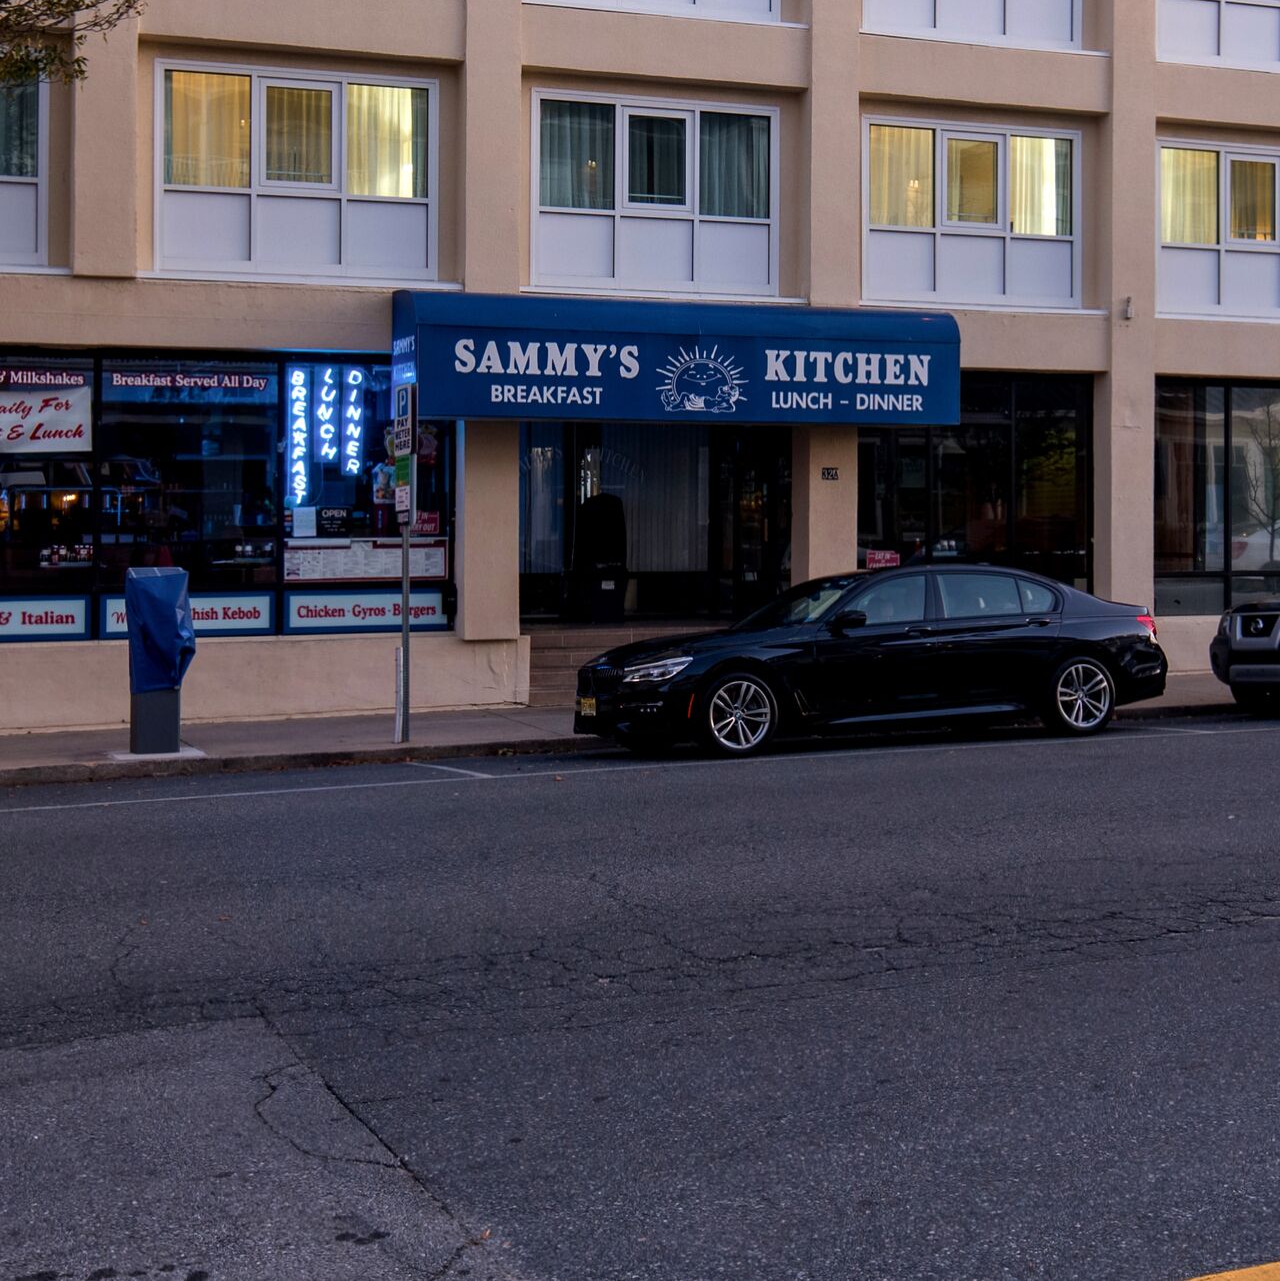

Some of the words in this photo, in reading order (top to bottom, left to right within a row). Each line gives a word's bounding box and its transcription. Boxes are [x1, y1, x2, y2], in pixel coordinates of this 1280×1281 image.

[454, 338, 640, 379] SAMMY'S
[765, 349, 931, 387] KITCHEN
[10, 370, 84, 385] Milkshakes
[112, 373, 172, 386] Breakfast
[175, 374, 218, 387] Served
[222, 375, 239, 387] All
[242, 376, 267, 390] Day
[491, 384, 603, 405] BREAKFAST
[771, 391, 833, 409] LUNCH
[856, 394, 923, 411] DINNER
[38, 396, 73, 414] For
[317, 368, 337, 460] LUNCH
[346, 370, 363, 474] DINNER
[397, 417, 408, 429] PAY
[7, 424, 25, 441] &
[29, 423, 84, 440] Lunch
[291, 370, 308, 504] BREAKFAST
[395, 439, 410, 452] HERE
[322, 509, 347, 518] OPEN
[21, 611, 76, 625] Italian
[191, 607, 218, 621] hish
[222, 606, 261, 620] Kebob
[297, 605, 345, 618] Chicken
[352, 604, 386, 620] Gyros
[392, 603, 436, 618] Brgers
